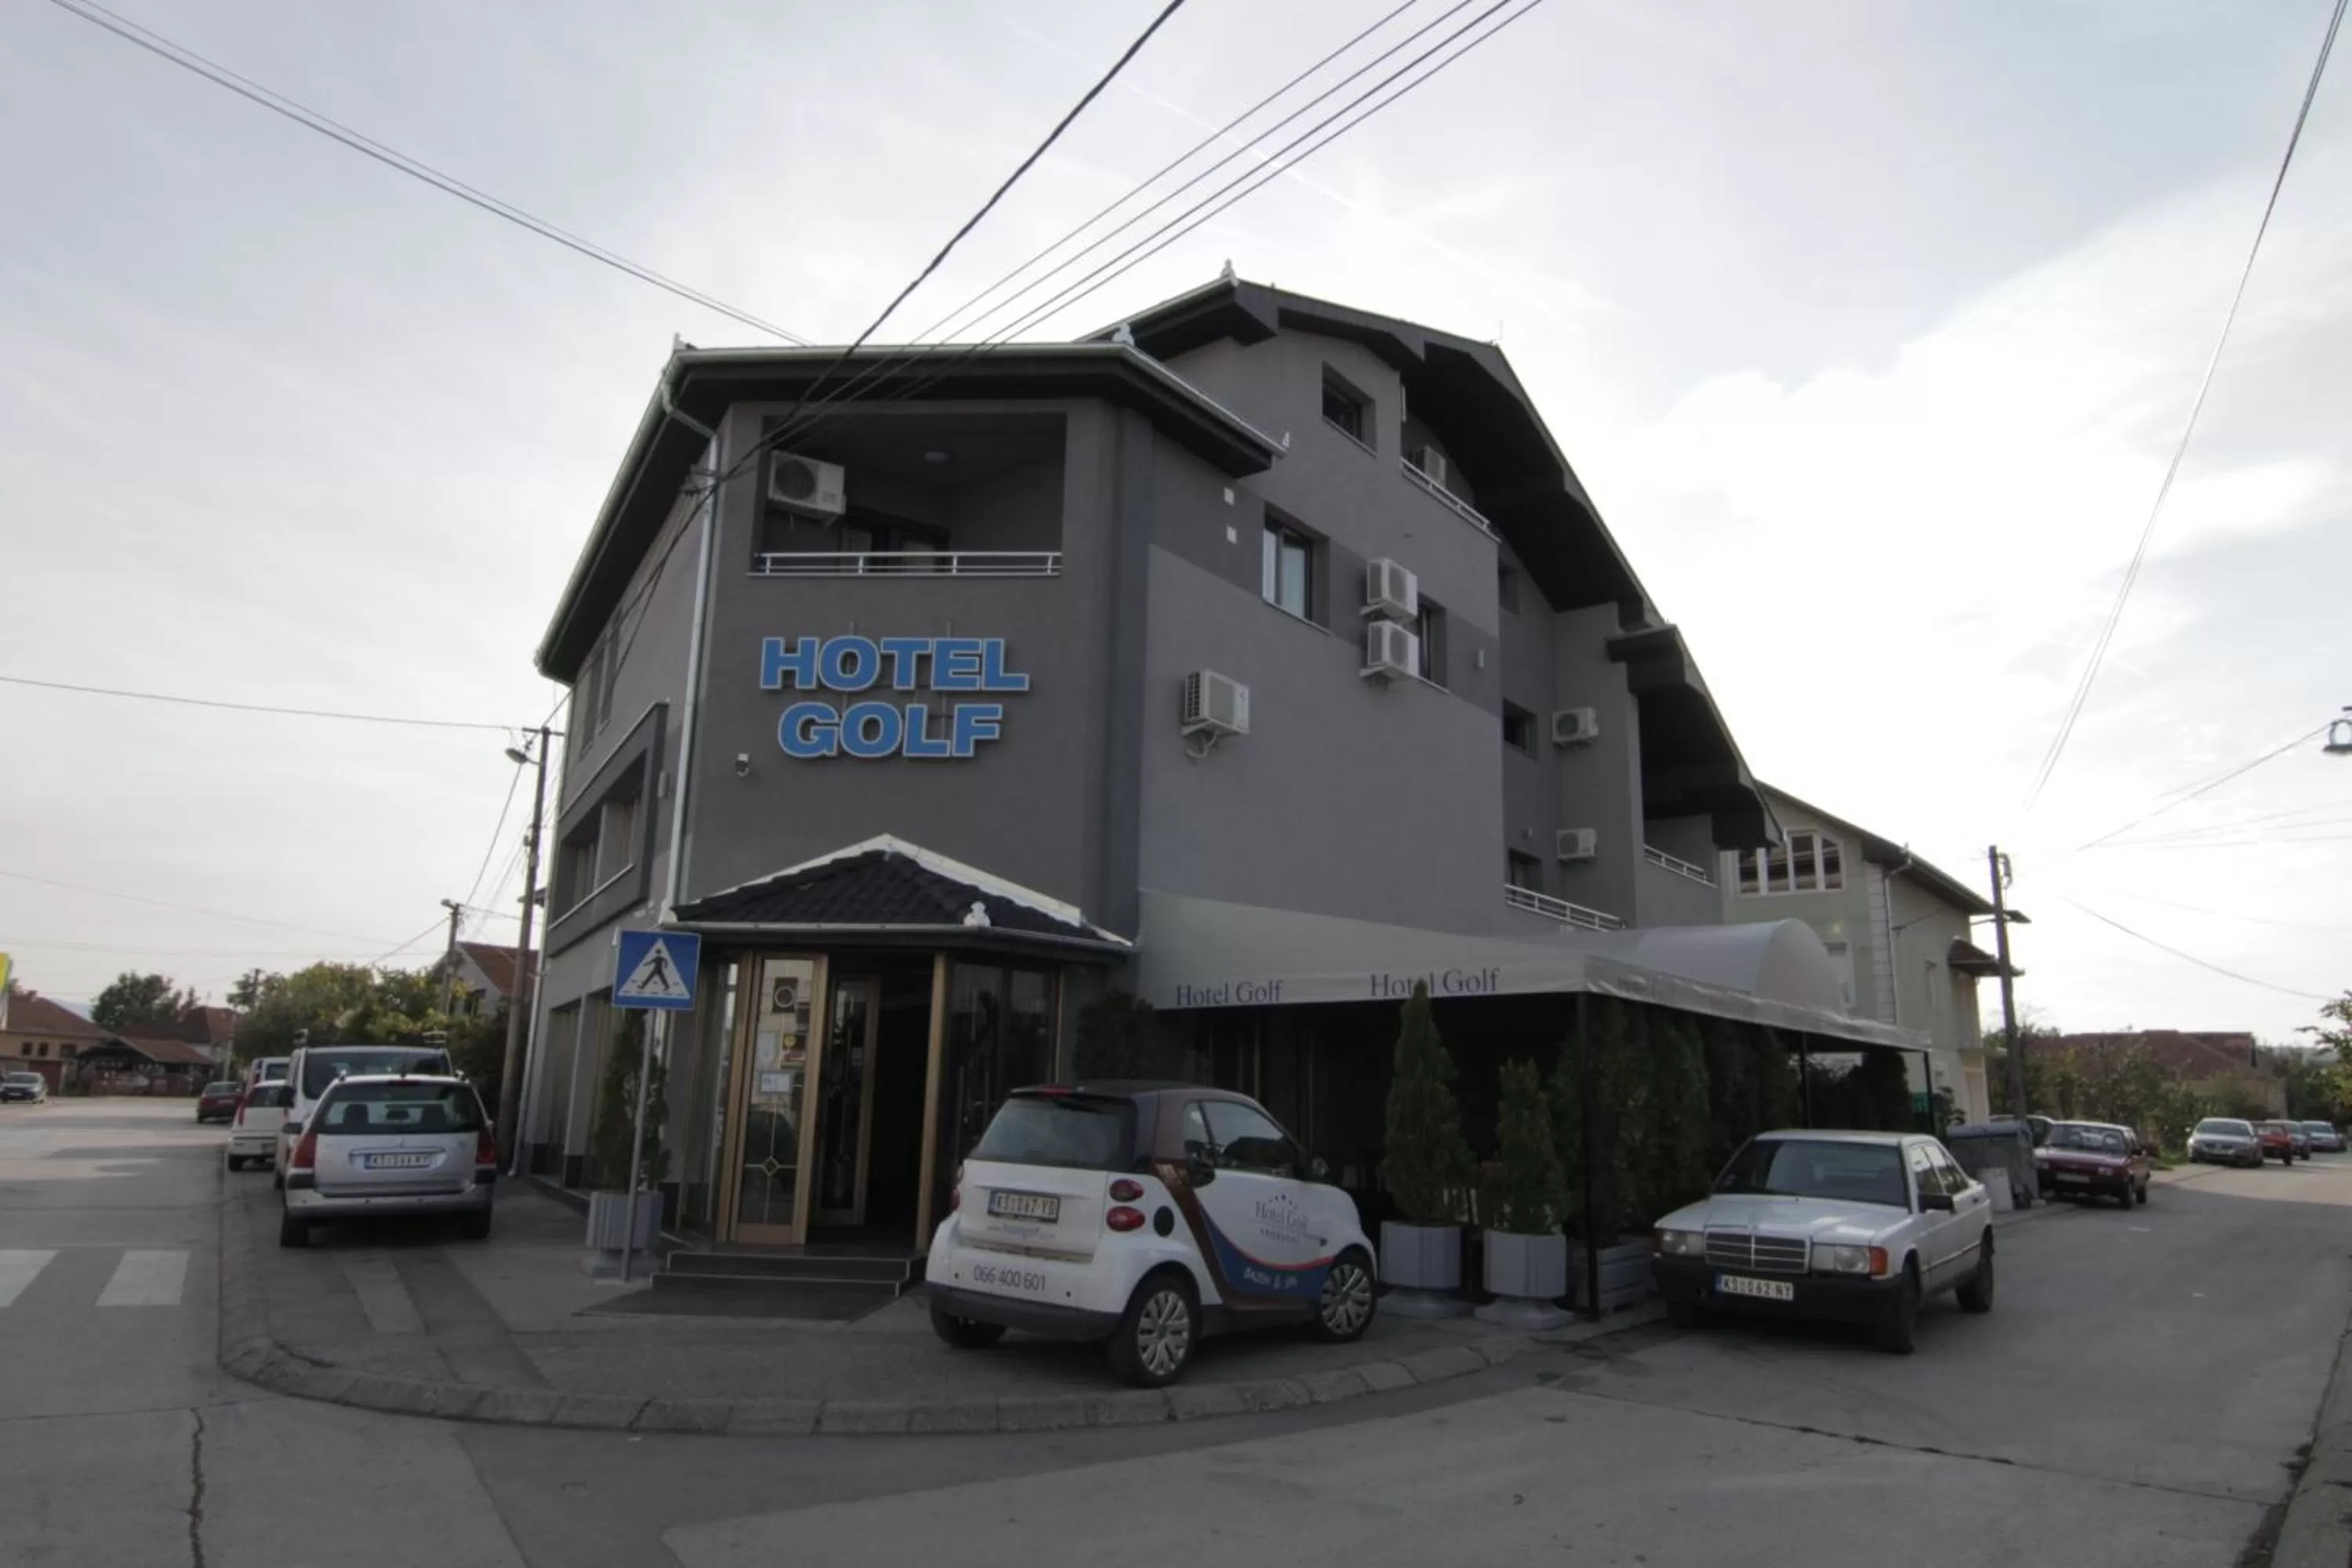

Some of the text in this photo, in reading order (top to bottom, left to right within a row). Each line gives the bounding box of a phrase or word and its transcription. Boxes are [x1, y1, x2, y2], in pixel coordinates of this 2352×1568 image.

[760, 636, 1029, 691] HOTEL
[777, 702, 1003, 758] GOLF
[1176, 978, 1284, 1006] Hotel Golf
[1370, 966, 1500, 996] Hotl Golf
[974, 1264, 1047, 1292] 066 400 601
